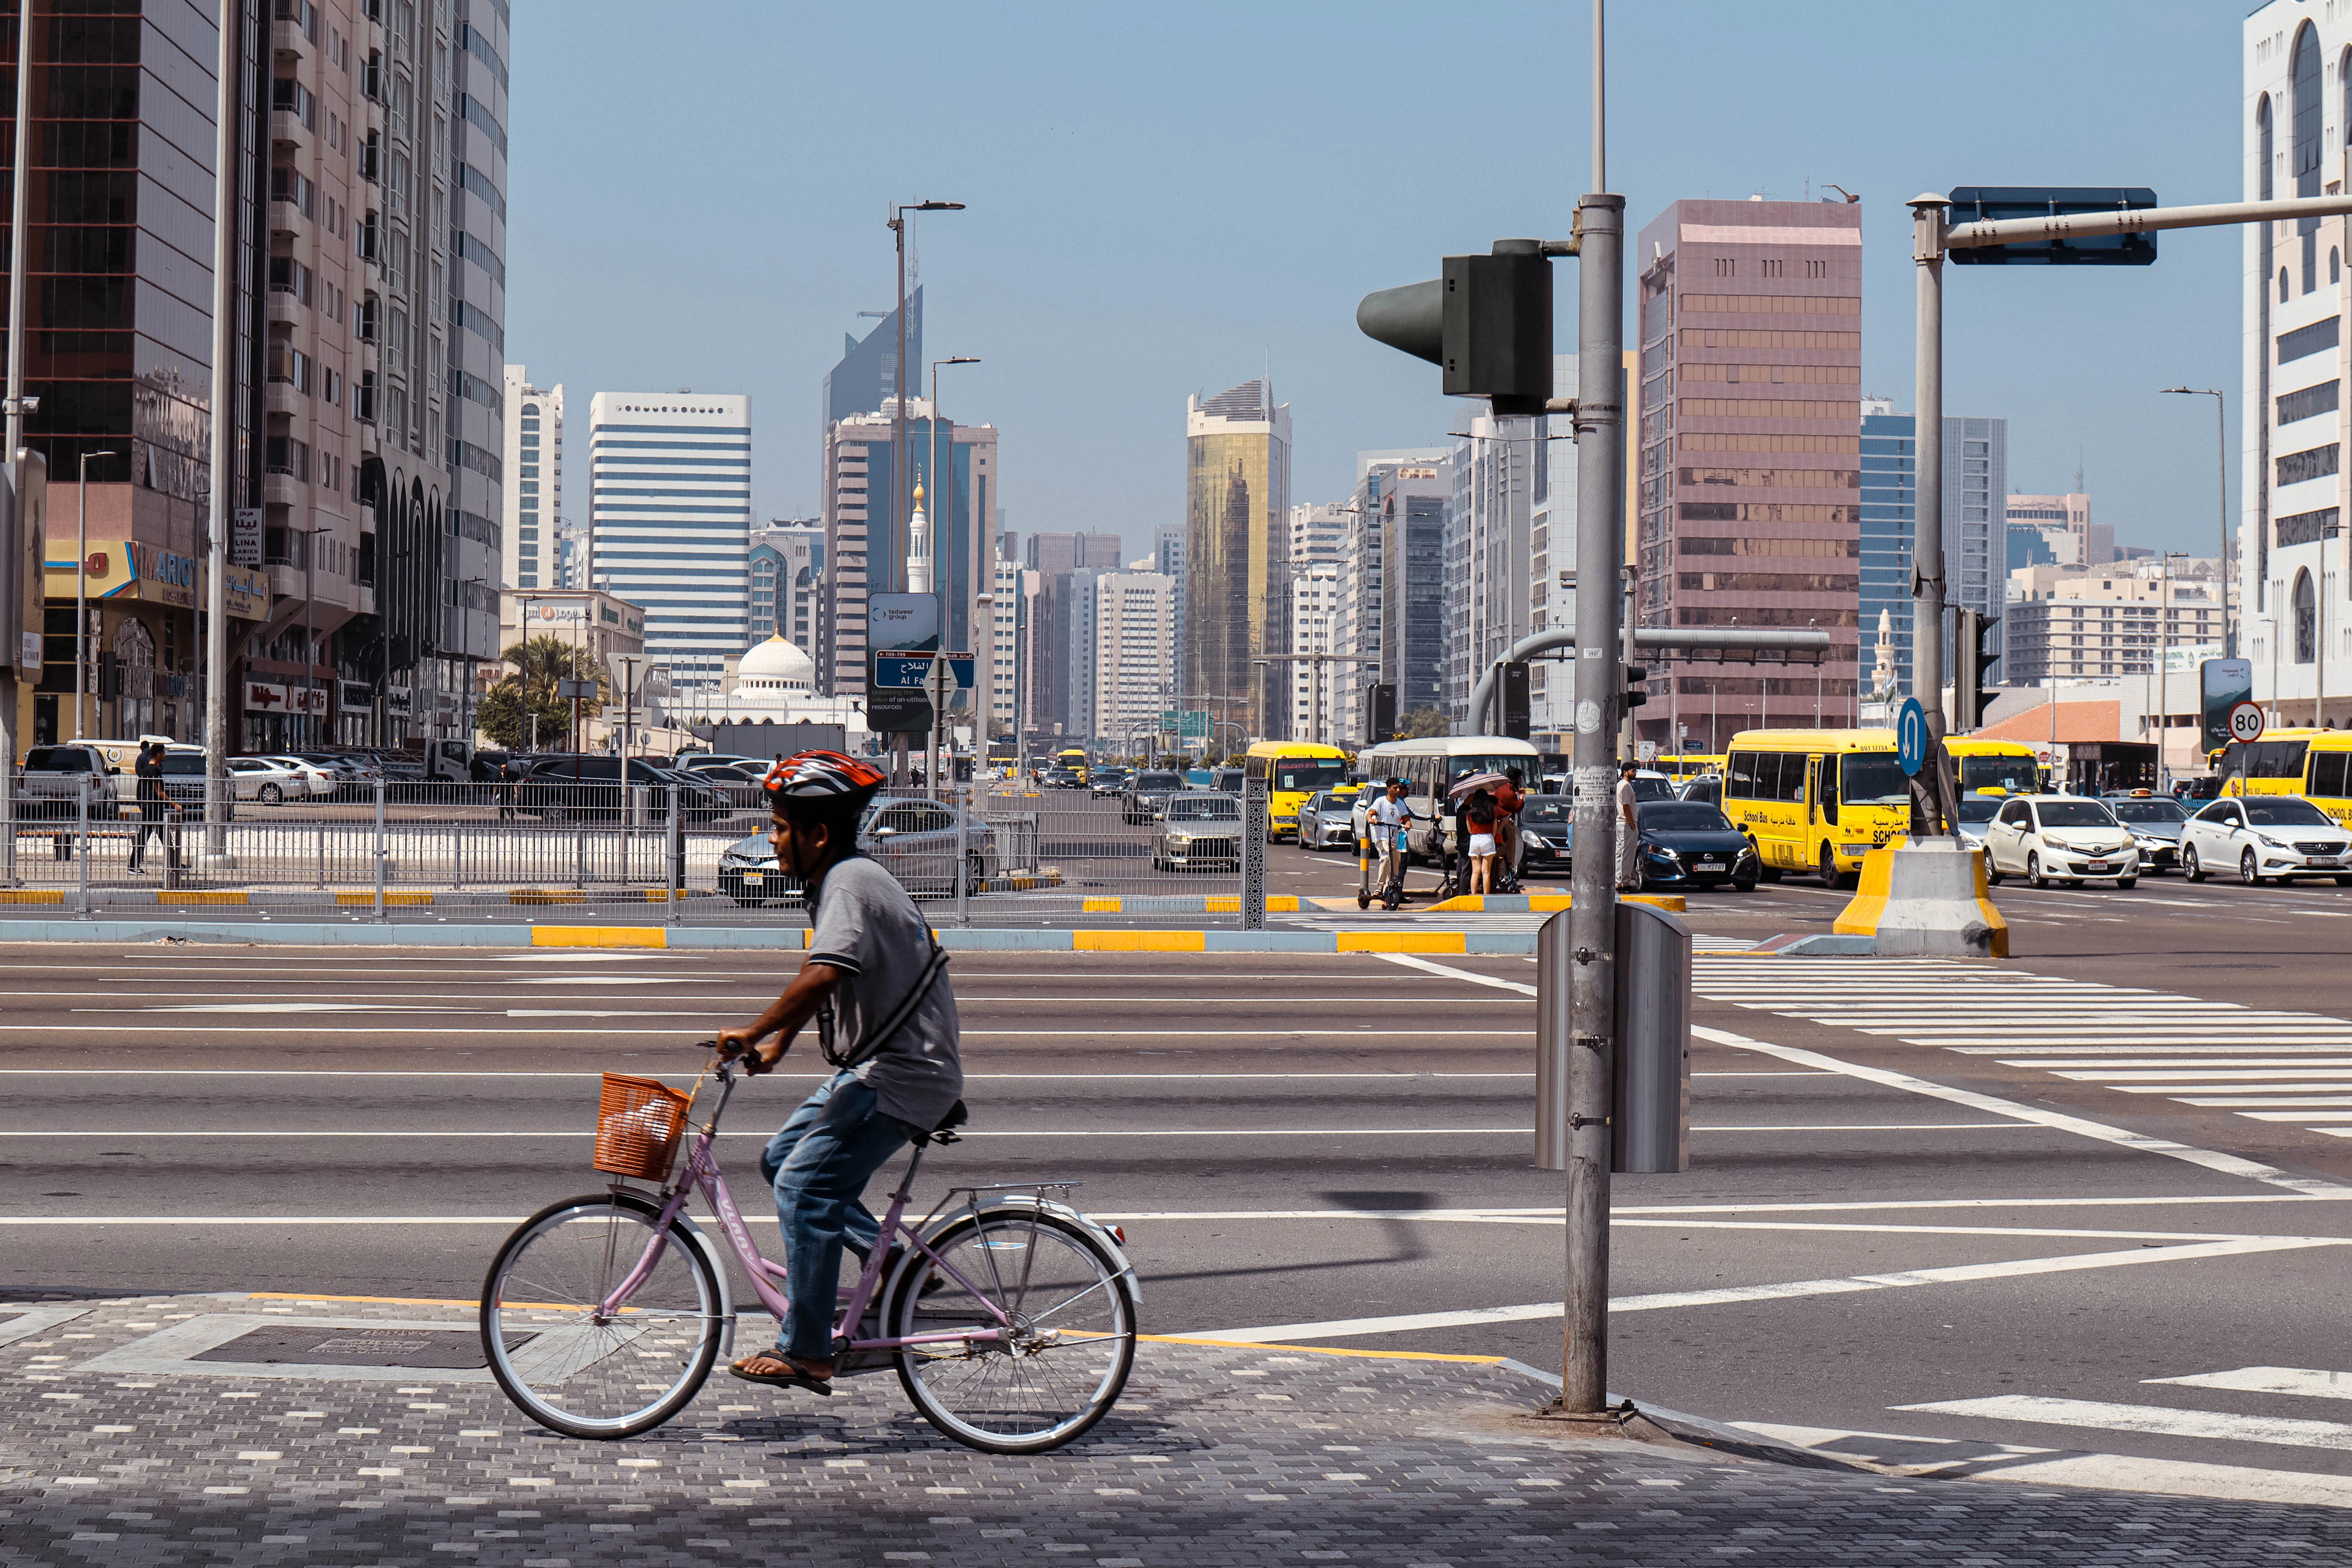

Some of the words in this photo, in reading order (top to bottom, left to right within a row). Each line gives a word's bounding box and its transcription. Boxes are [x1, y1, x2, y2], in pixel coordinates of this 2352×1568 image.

[900, 662, 929, 673] الفلاح
[2236, 714, 2258, 731] 80
[1744, 810, 1758, 822] School
[1759, 812, 1768, 824] Bus
[1872, 815, 1903, 828] مدرسية
